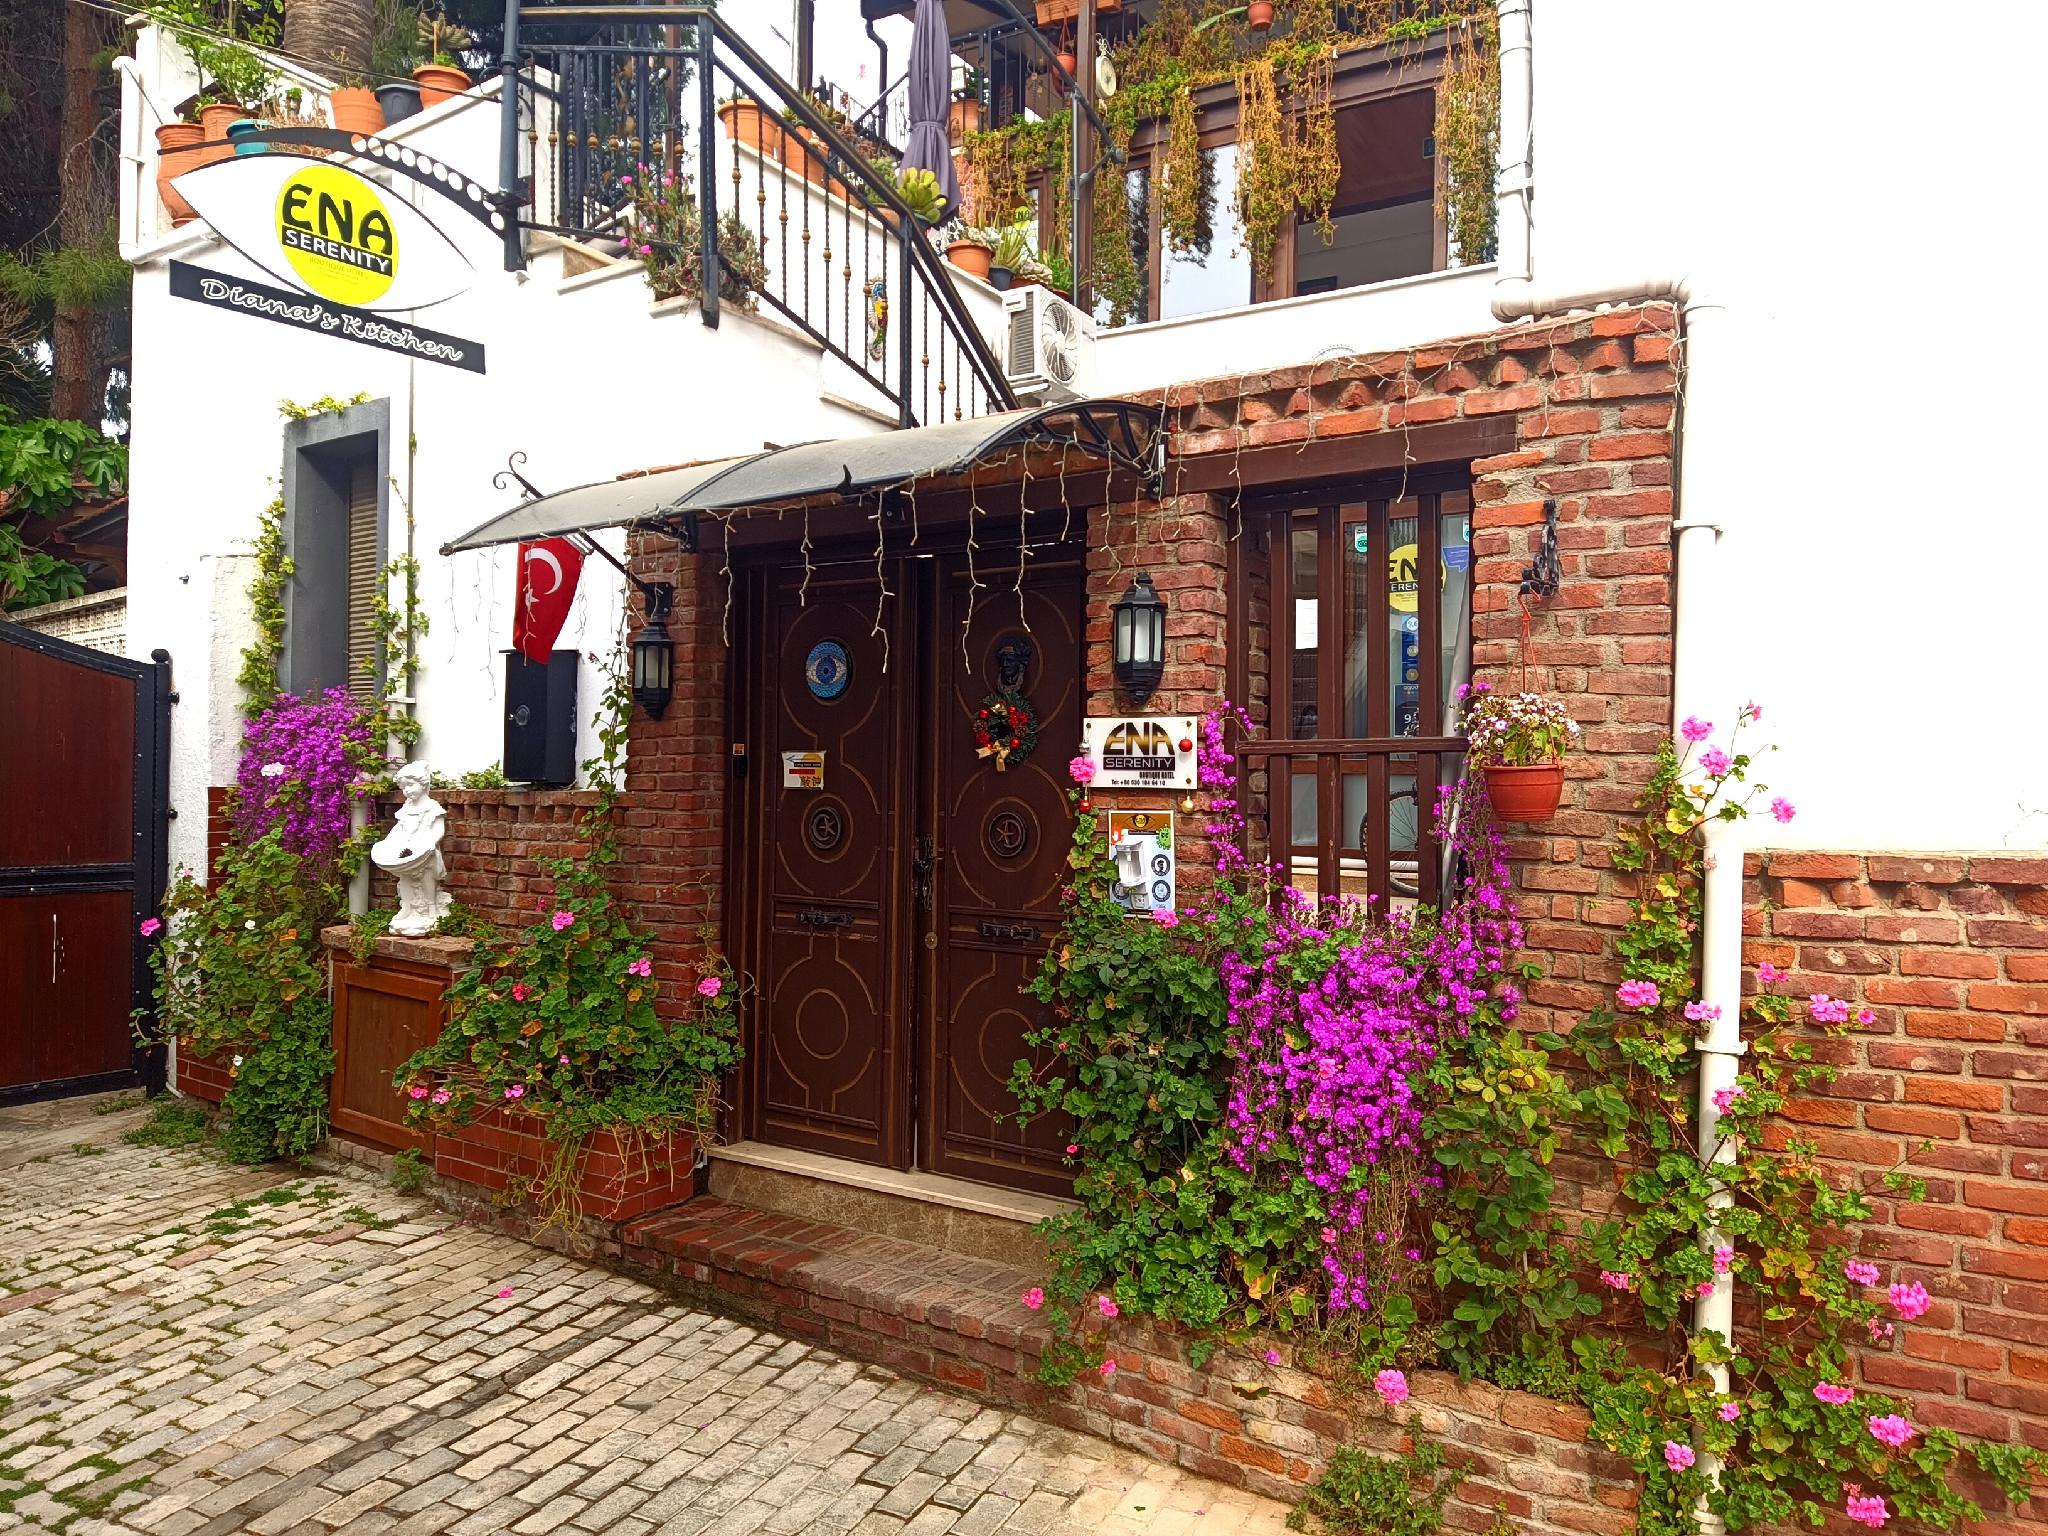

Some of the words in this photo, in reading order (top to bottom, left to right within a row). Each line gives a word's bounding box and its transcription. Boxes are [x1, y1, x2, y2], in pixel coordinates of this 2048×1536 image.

[282, 184, 392, 256] ENA
[285, 229, 389, 272] SERENITY
[201, 278, 339, 329] Diana's
[341, 313, 464, 361] Kitchen
[1391, 582, 1419, 592] EREN
[1103, 722, 1175, 755] ENA
[1105, 758, 1173, 768] SERENITY
